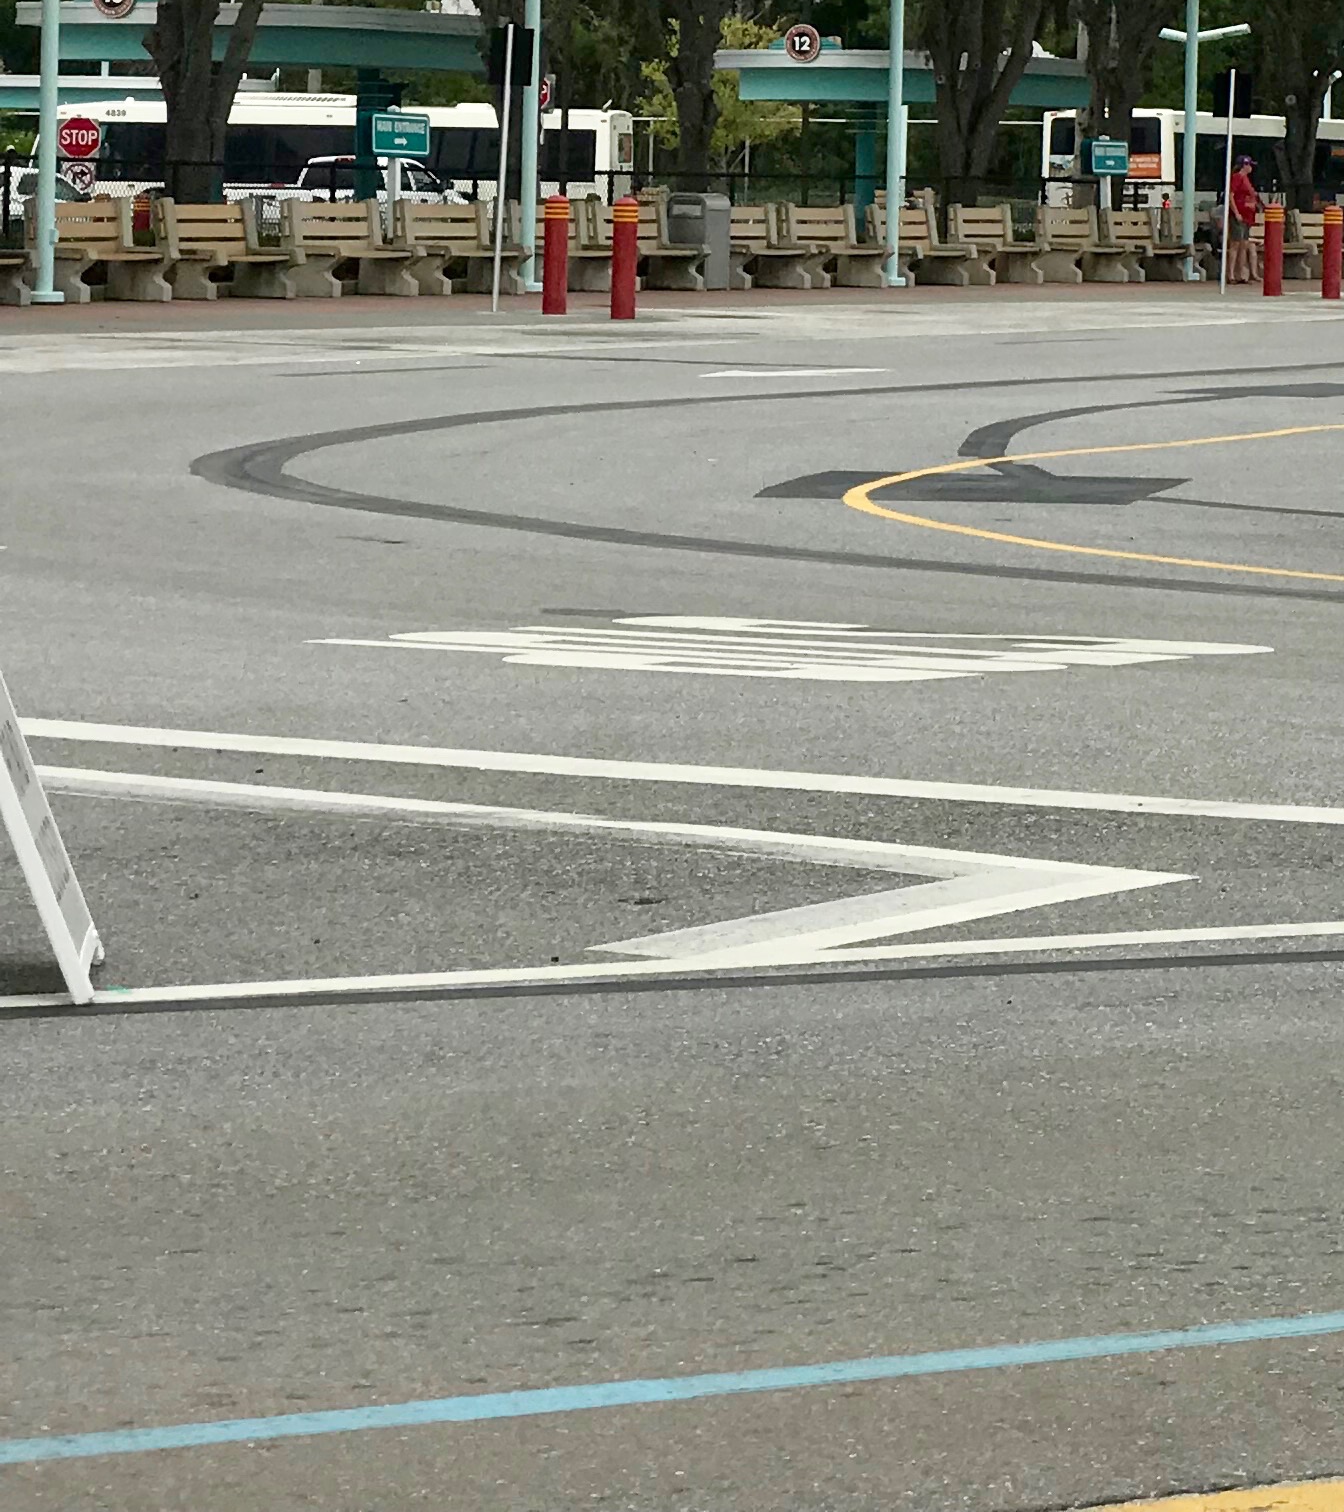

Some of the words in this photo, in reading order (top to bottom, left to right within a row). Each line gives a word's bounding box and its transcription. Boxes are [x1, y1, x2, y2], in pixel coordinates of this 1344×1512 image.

[793, 35, 811, 51] 12
[60, 129, 99, 146] STOP
[303, 615, 1274, 682] STOP
